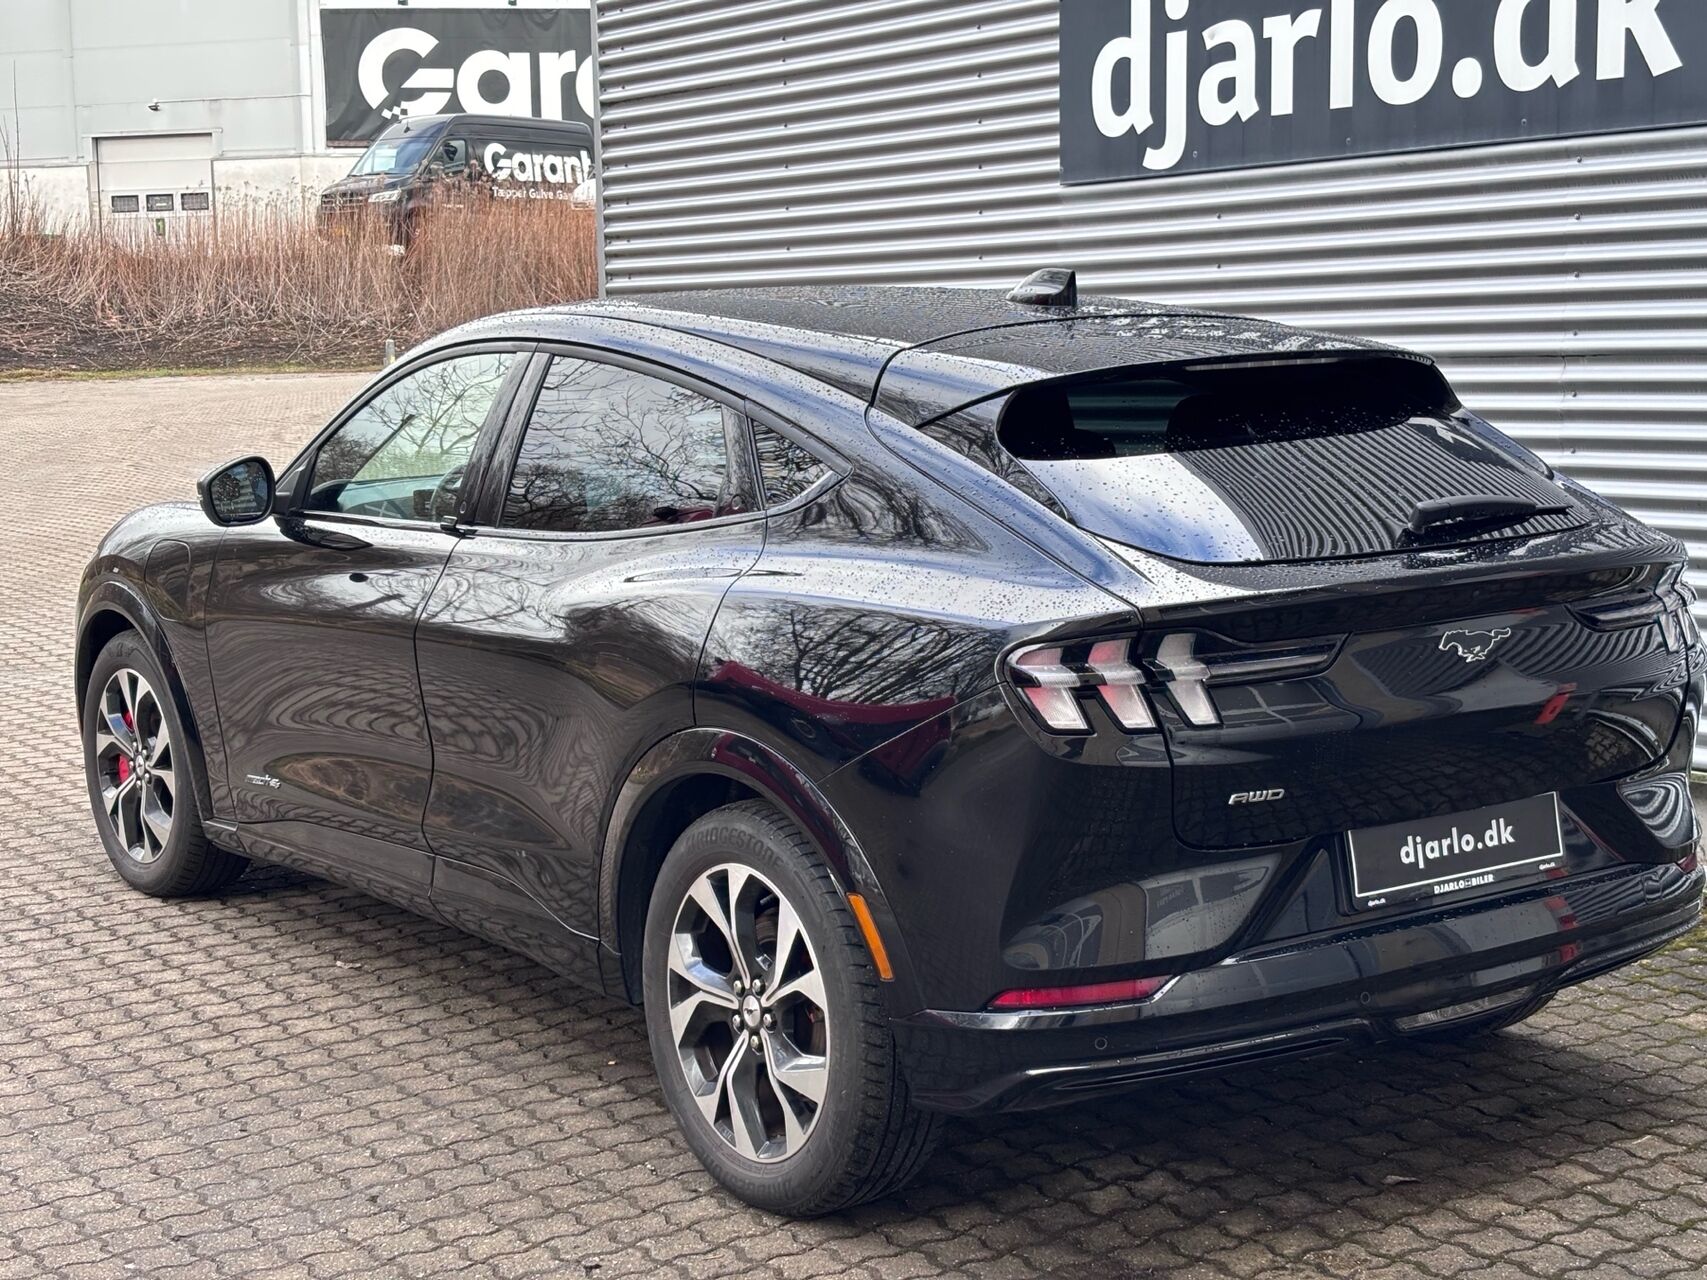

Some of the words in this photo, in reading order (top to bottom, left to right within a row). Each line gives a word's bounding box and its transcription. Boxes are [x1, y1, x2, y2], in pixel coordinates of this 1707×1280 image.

[358, 27, 594, 120] Gar
[1091, 0, 1683, 170] djarlo.dk
[1228, 788, 1285, 805] AWD
[1400, 818, 1515, 869] djarlo.dk
[1433, 880, 1465, 894] DJARLO
[1471, 874, 1494, 887] BILER
